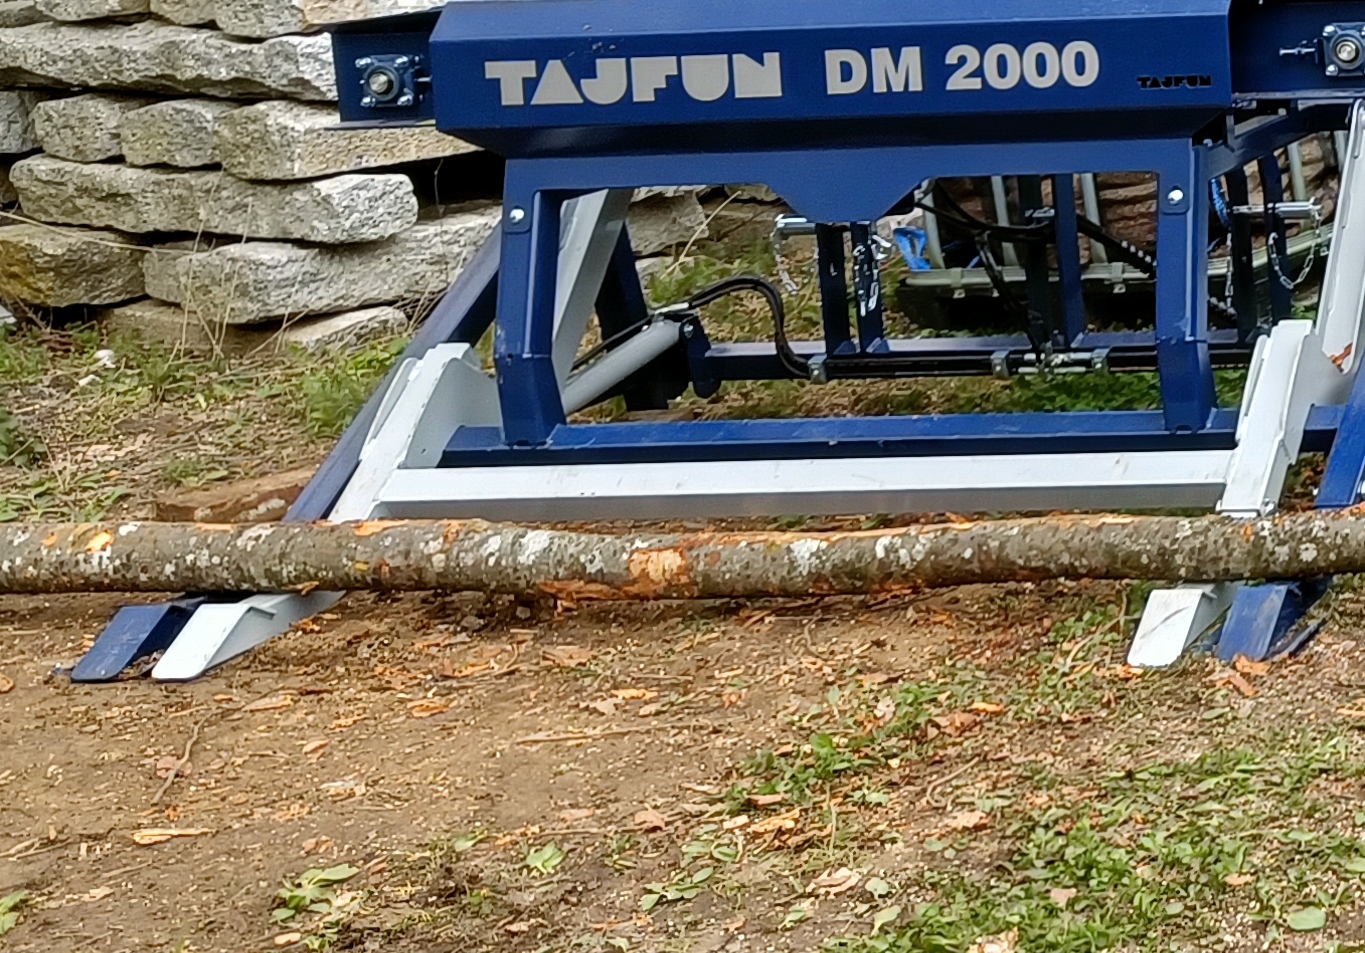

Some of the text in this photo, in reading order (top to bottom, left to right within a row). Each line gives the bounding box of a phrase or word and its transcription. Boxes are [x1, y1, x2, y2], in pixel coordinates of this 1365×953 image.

[484, 40, 1100, 106] TAJFUN DM 2000
[1136, 74, 1212, 89] TAJFUN
